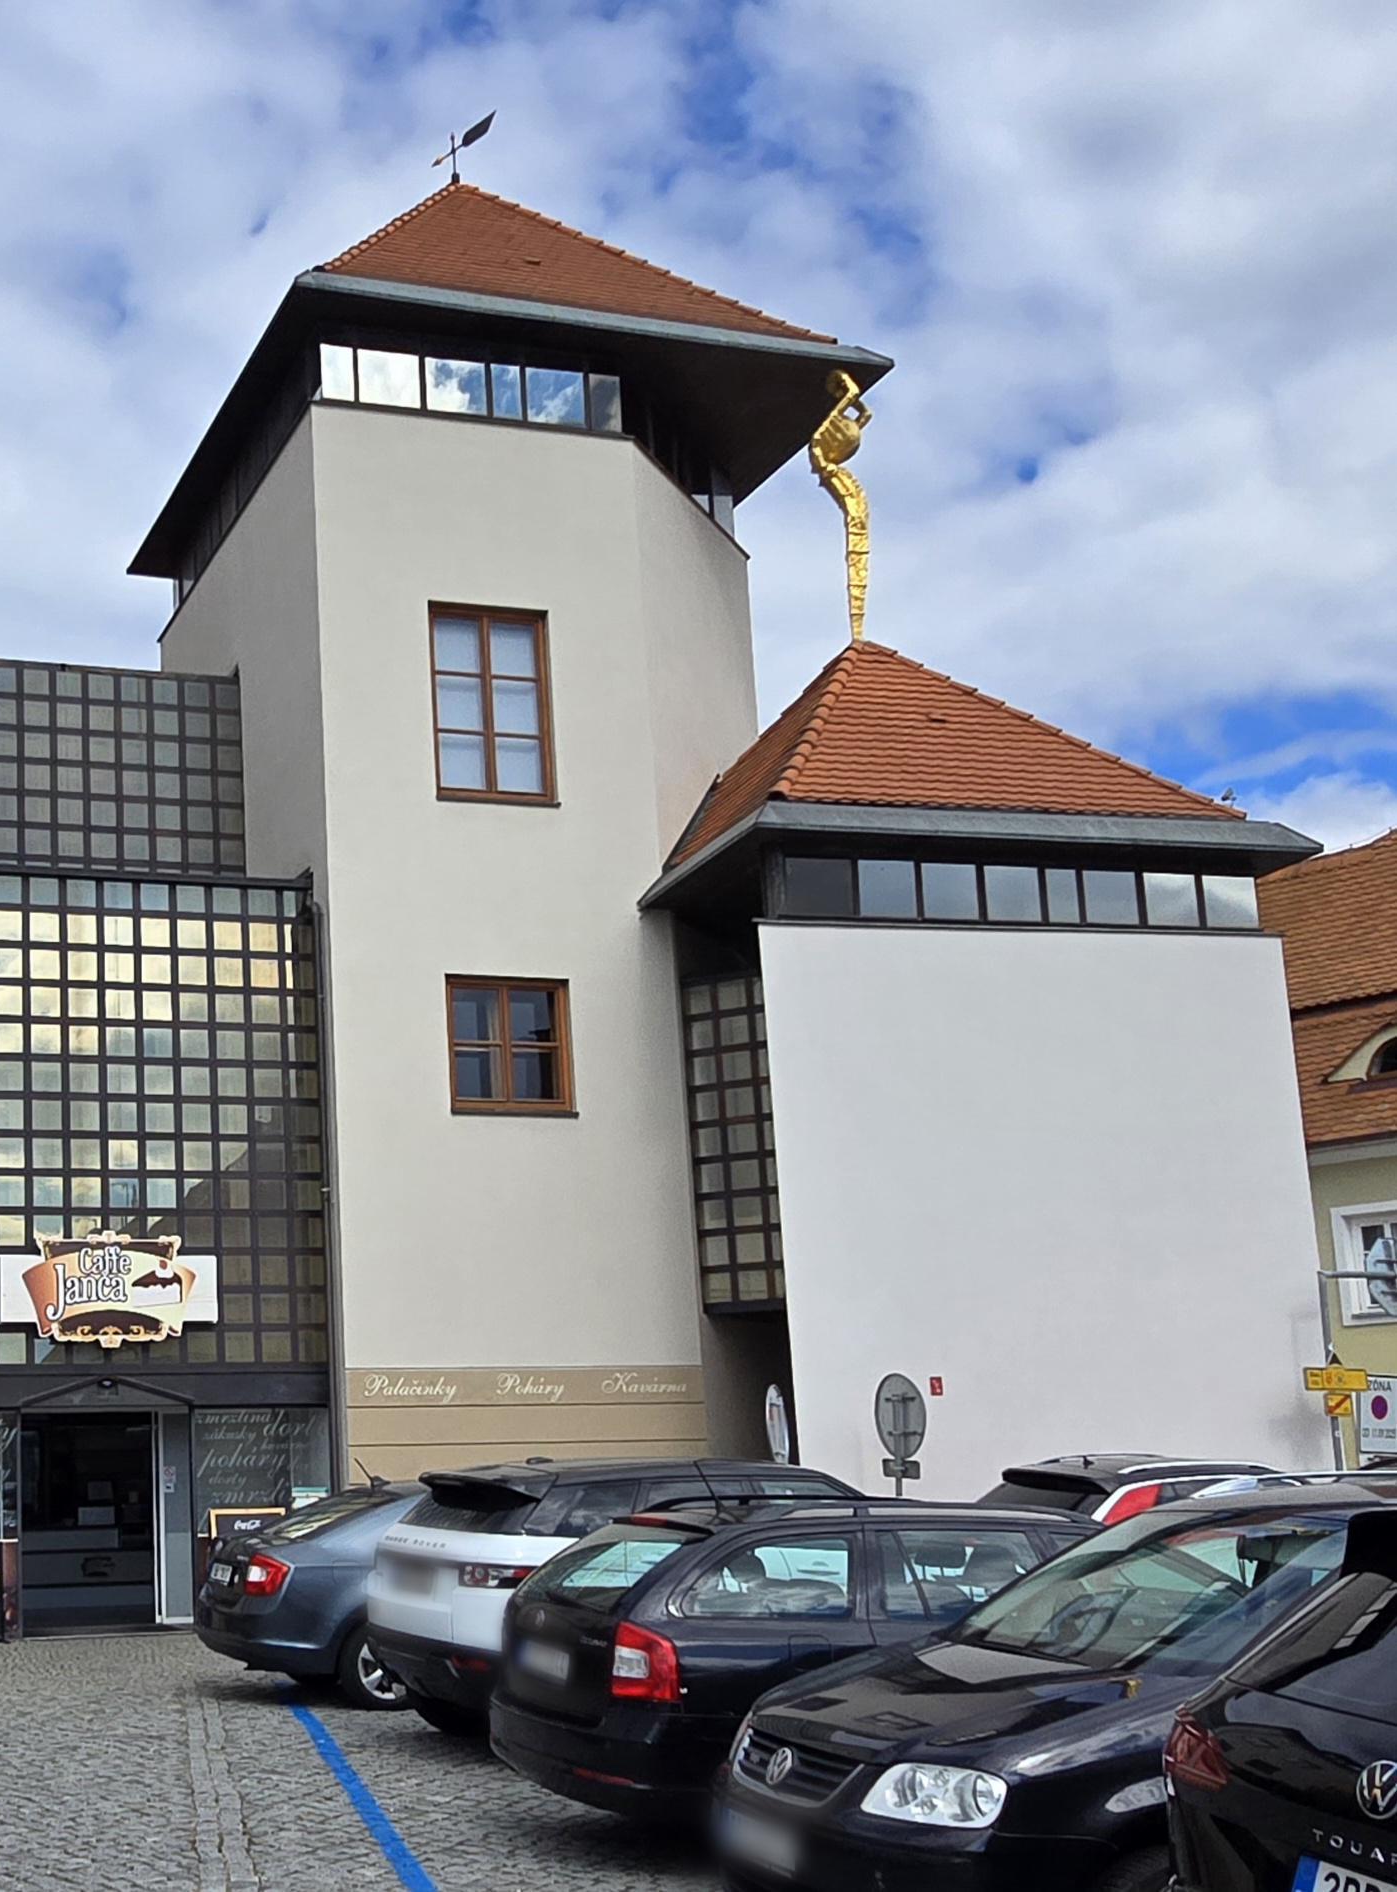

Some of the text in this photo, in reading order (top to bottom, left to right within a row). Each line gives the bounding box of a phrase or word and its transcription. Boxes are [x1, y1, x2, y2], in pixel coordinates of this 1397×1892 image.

[79, 1246, 132, 1278] Caffe
[46, 1263, 128, 1320] Janča
[363, 1372, 687, 1402] Palačinky Poháry Kavárna
